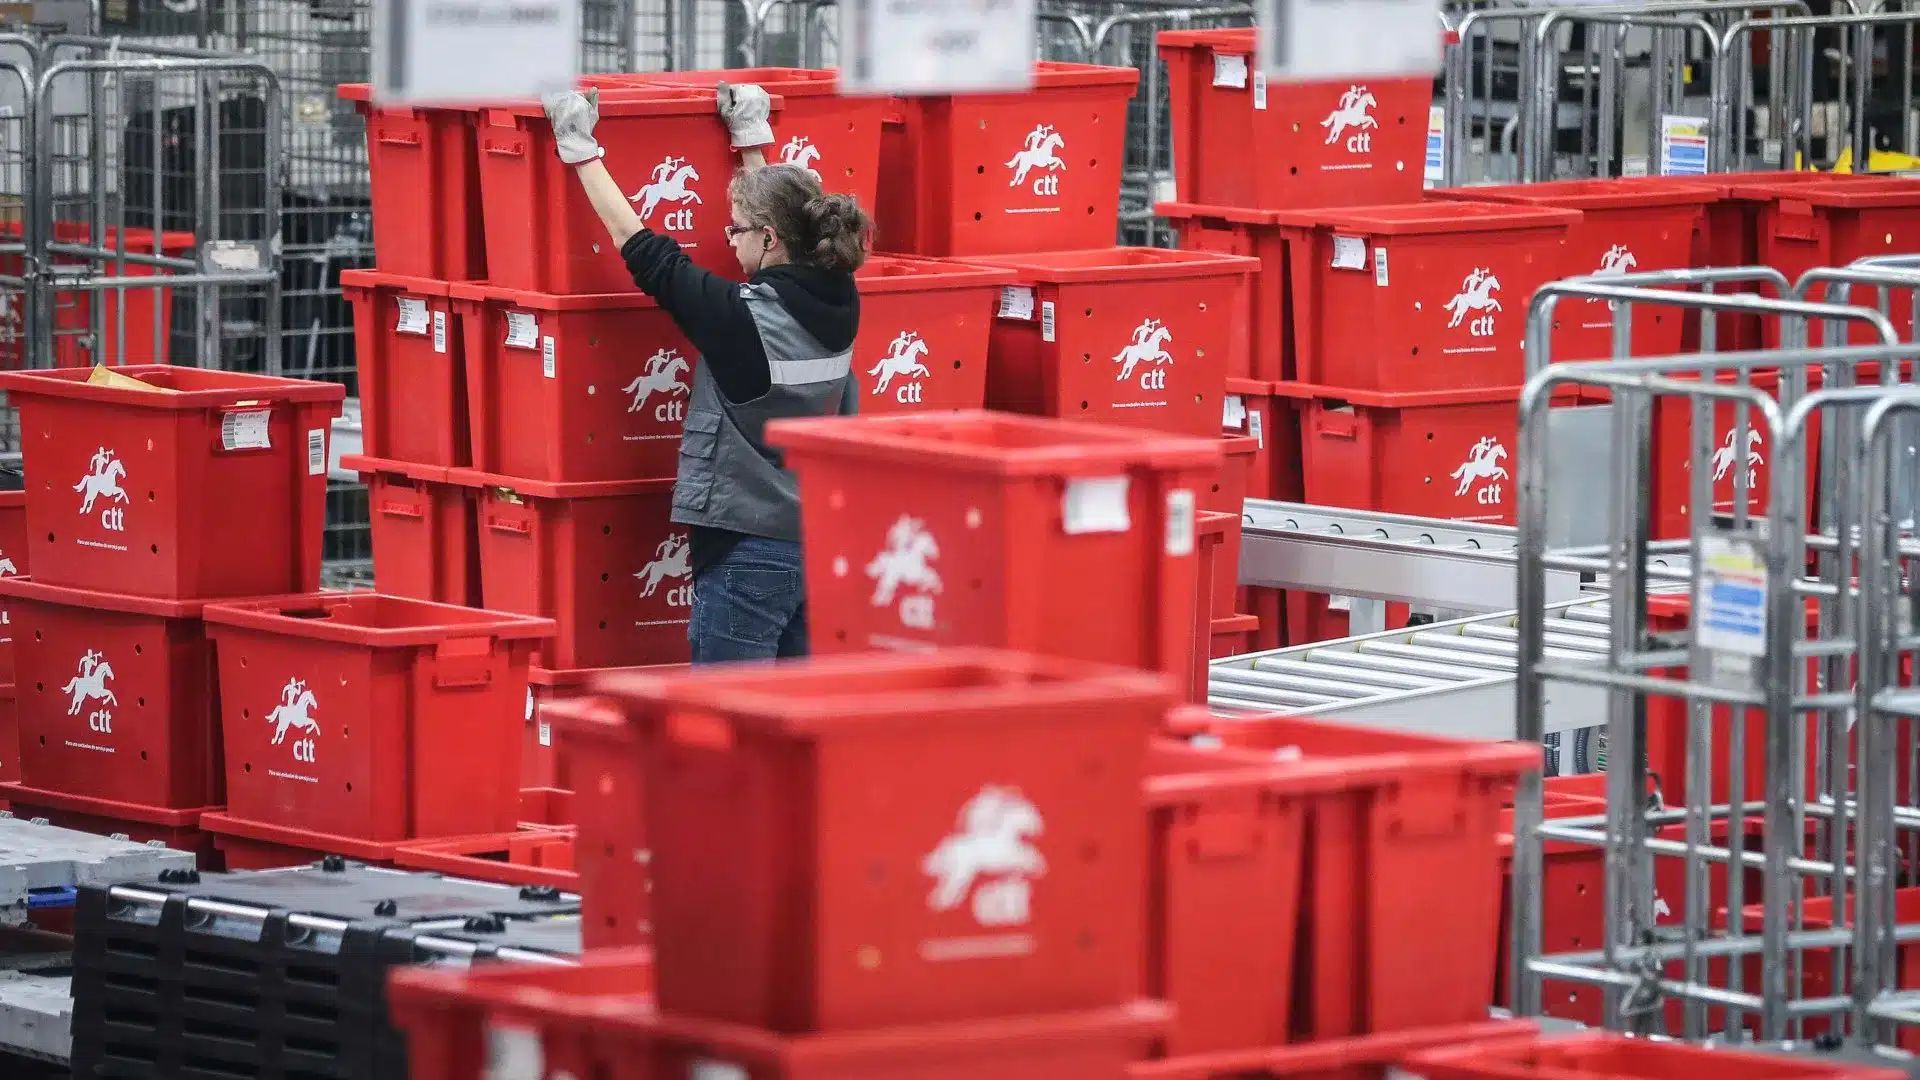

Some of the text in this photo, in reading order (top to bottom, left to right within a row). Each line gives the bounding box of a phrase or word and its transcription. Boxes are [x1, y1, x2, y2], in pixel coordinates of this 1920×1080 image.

[1347, 133, 1371, 153] ctt
[1033, 175, 1059, 196] ctt
[664, 208, 694, 231] ctt
[1470, 316, 1495, 337] ctt
[1140, 368, 1166, 390] ctt
[896, 382, 922, 404] ctt
[655, 400, 683, 422] ctt
[1477, 483, 1502, 505] ctt
[101, 507, 124, 532] ctt
[89, 708, 112, 734] ctt
[293, 737, 316, 763] ctt
